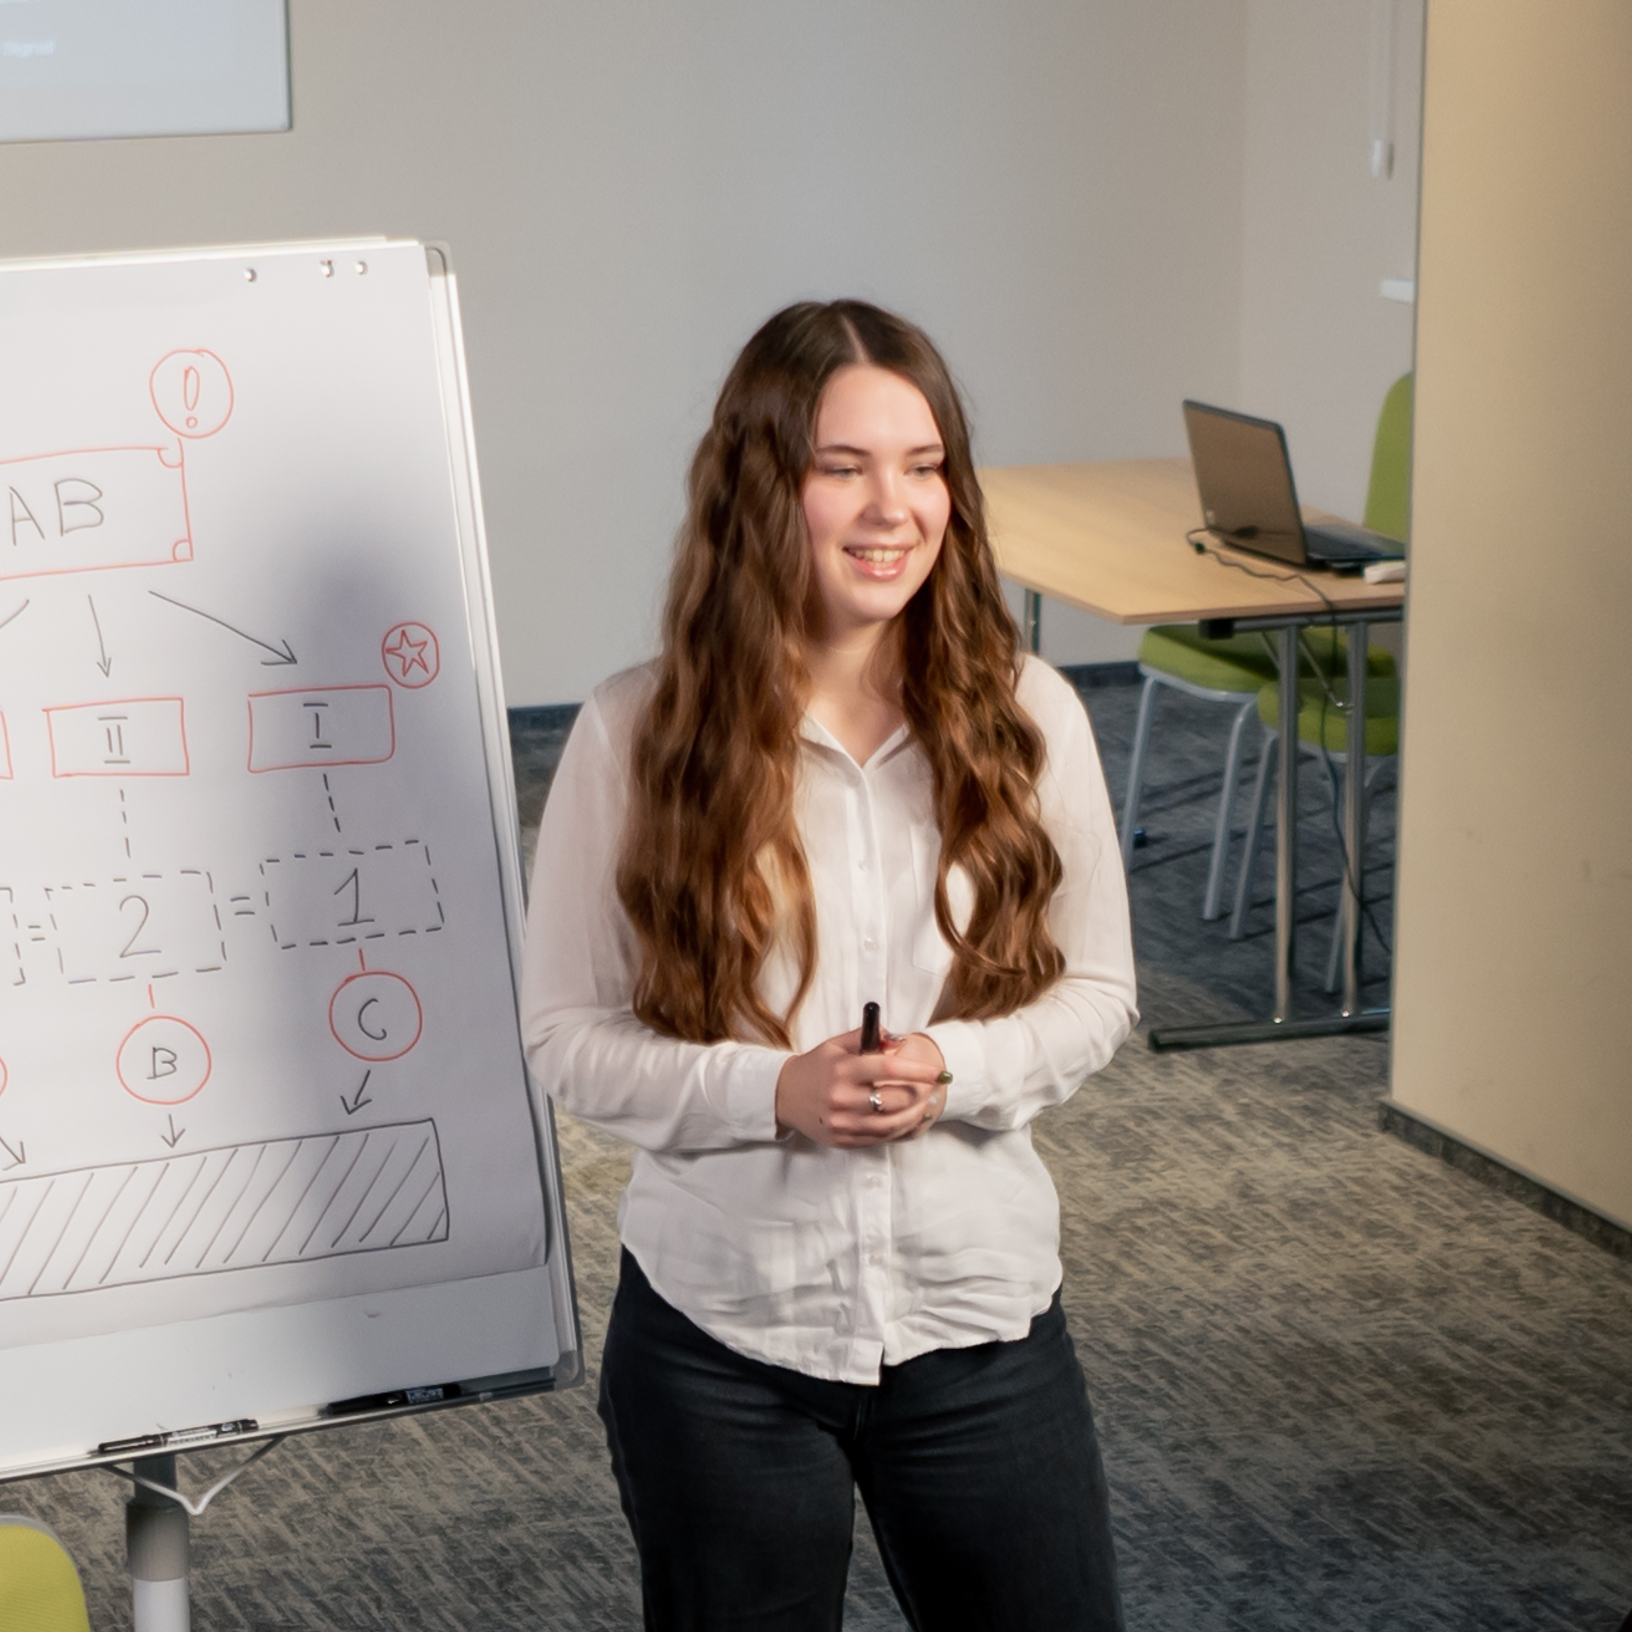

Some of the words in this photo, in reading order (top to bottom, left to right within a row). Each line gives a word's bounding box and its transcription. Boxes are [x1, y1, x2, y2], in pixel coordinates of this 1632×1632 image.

[6, 477, 105, 546] AB
[118, 895, 162, 959] 2
[334, 868, 375, 927] 1
[357, 998, 387, 1041] C
[146, 1046, 178, 1080] B
